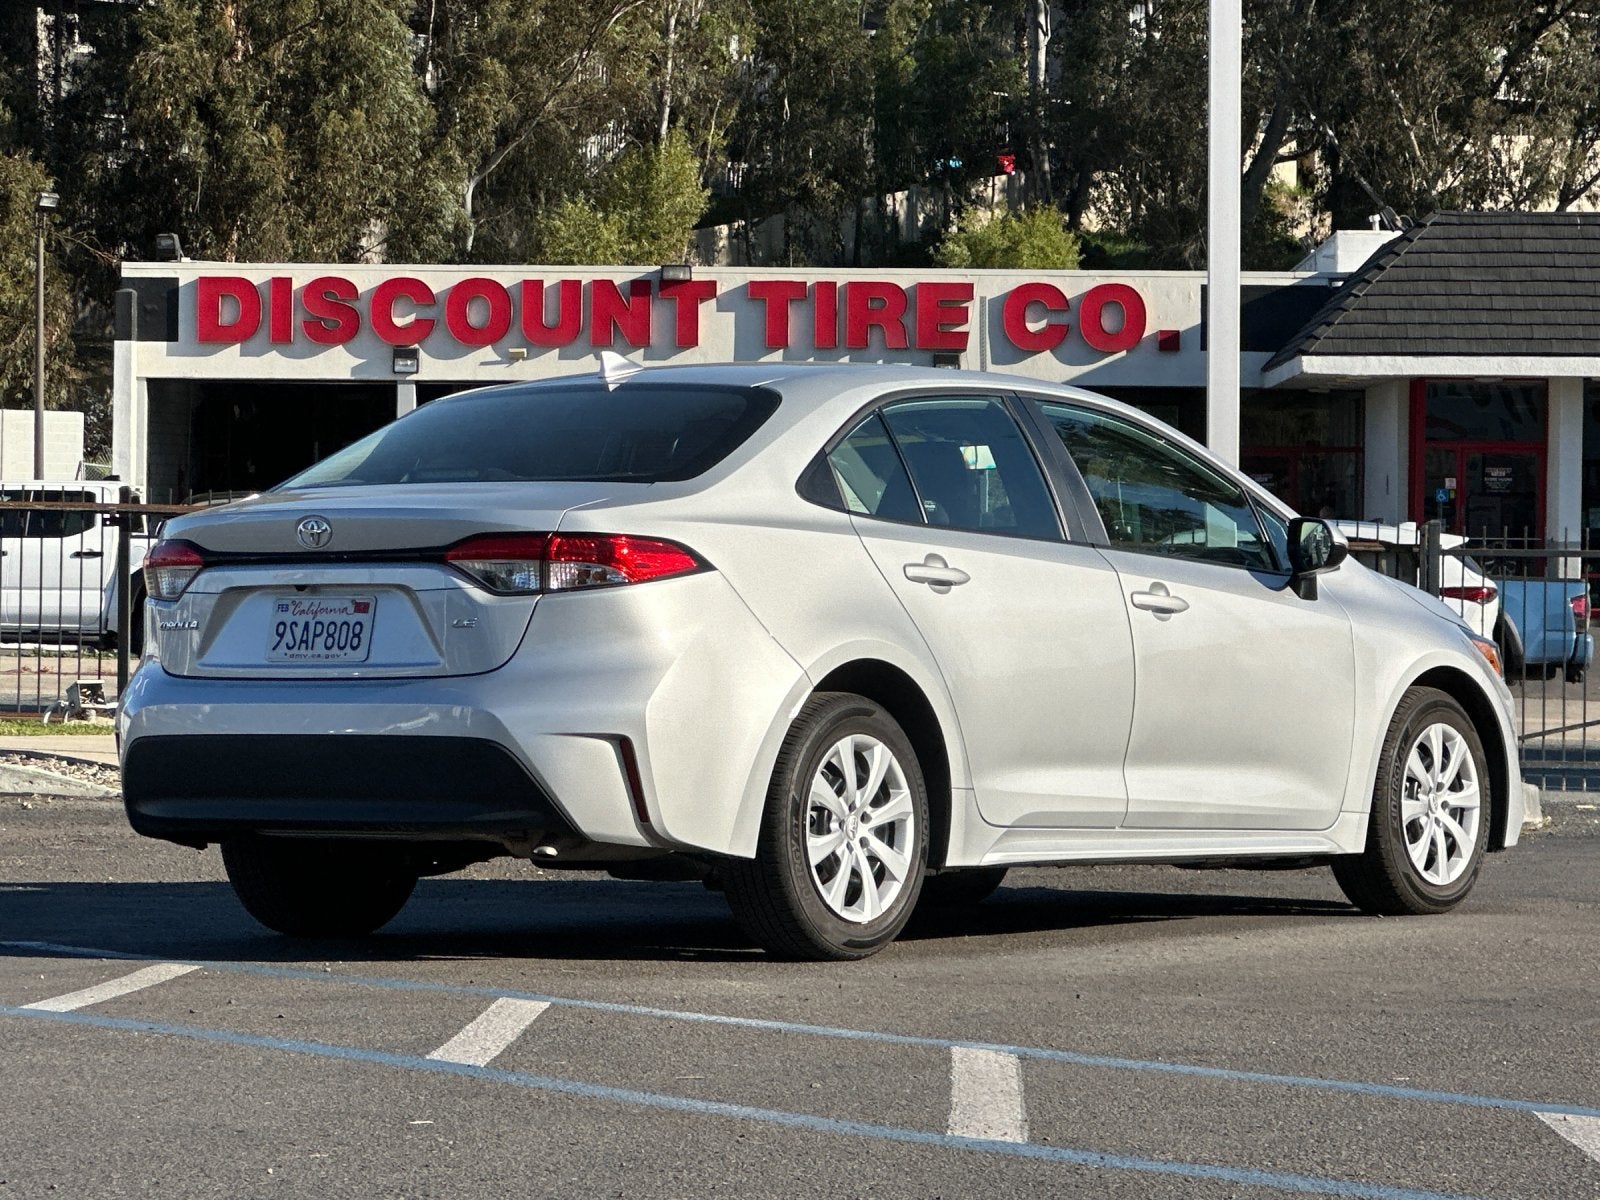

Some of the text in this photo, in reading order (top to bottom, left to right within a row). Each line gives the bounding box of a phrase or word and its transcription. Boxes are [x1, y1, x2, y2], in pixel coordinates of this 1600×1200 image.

[197, 276, 1180, 354] DISCOUNT TIRE CO.
[291, 600, 354, 620] California
[272, 621, 364, 651] 9SAP808
